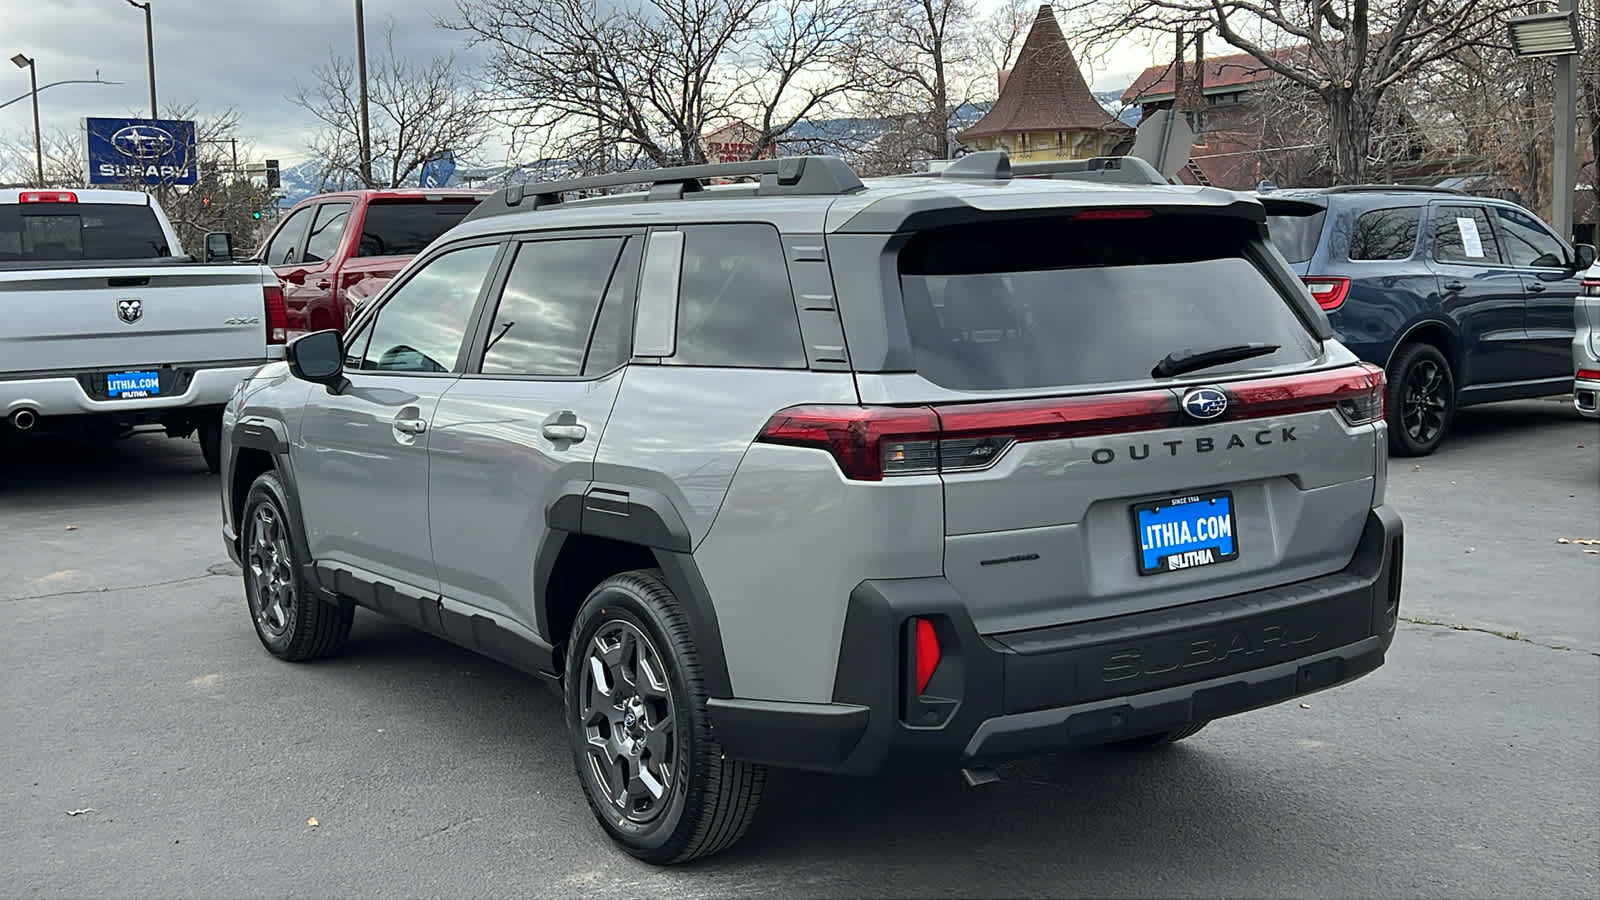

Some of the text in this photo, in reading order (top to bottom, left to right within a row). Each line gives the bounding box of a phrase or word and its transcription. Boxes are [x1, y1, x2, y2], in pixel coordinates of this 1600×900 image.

[99, 164, 189, 178] SUBARU
[107, 378, 159, 391] LITHIA.COM
[1091, 427, 1297, 465] OUTBACK
[1141, 514, 1231, 550] LITHIA.COM
[1179, 549, 1214, 569] LITHIA
